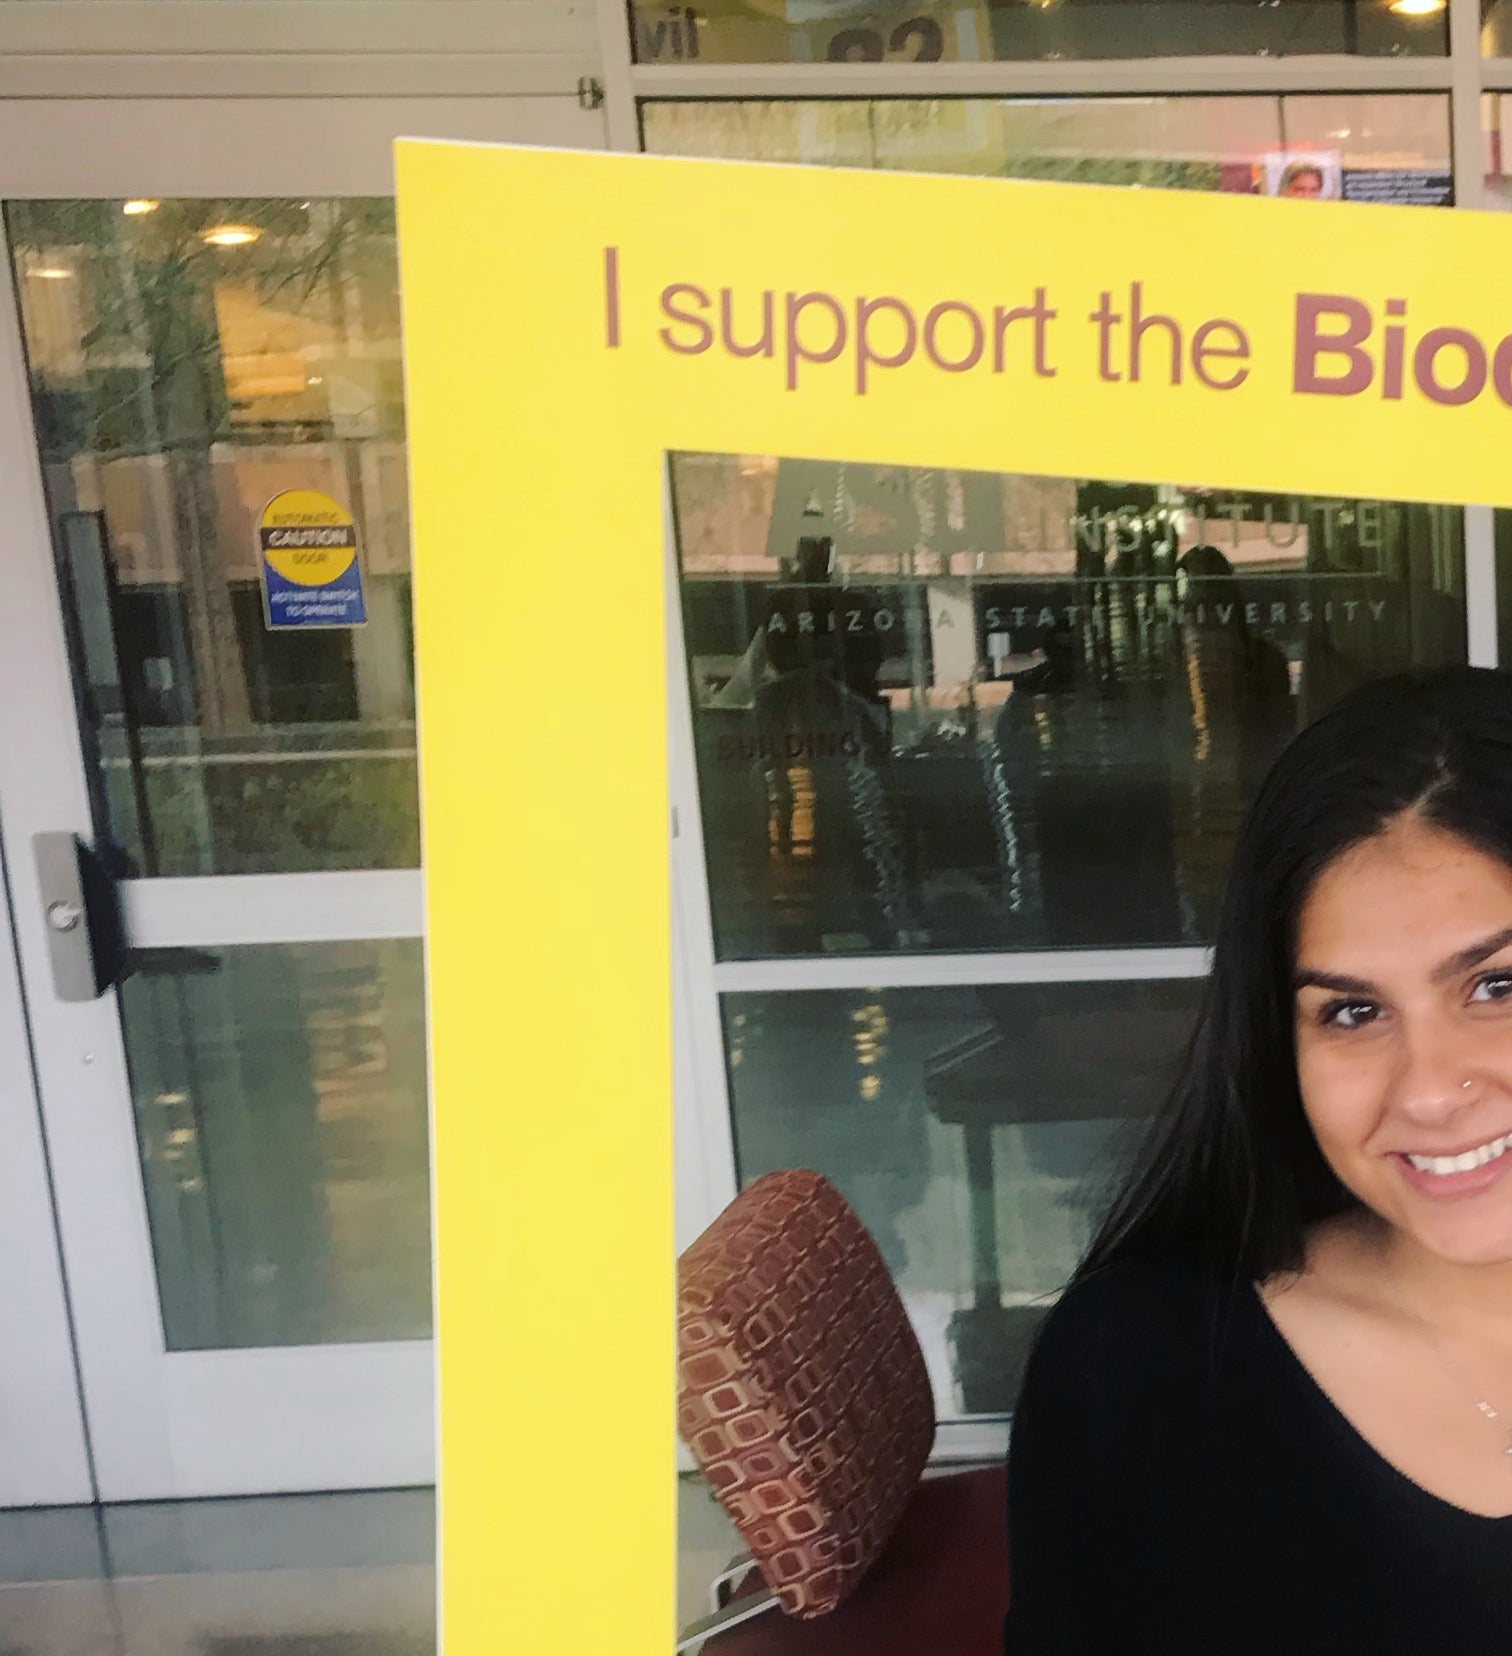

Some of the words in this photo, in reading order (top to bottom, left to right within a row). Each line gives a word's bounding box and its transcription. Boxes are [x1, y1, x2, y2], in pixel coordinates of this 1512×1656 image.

[604, 246, 620, 348] I
[658, 281, 1058, 396] support
[1090, 281, 1251, 391] the
[268, 529, 349, 546] CAUTION
[767, 607, 955, 633] ARIZOA
